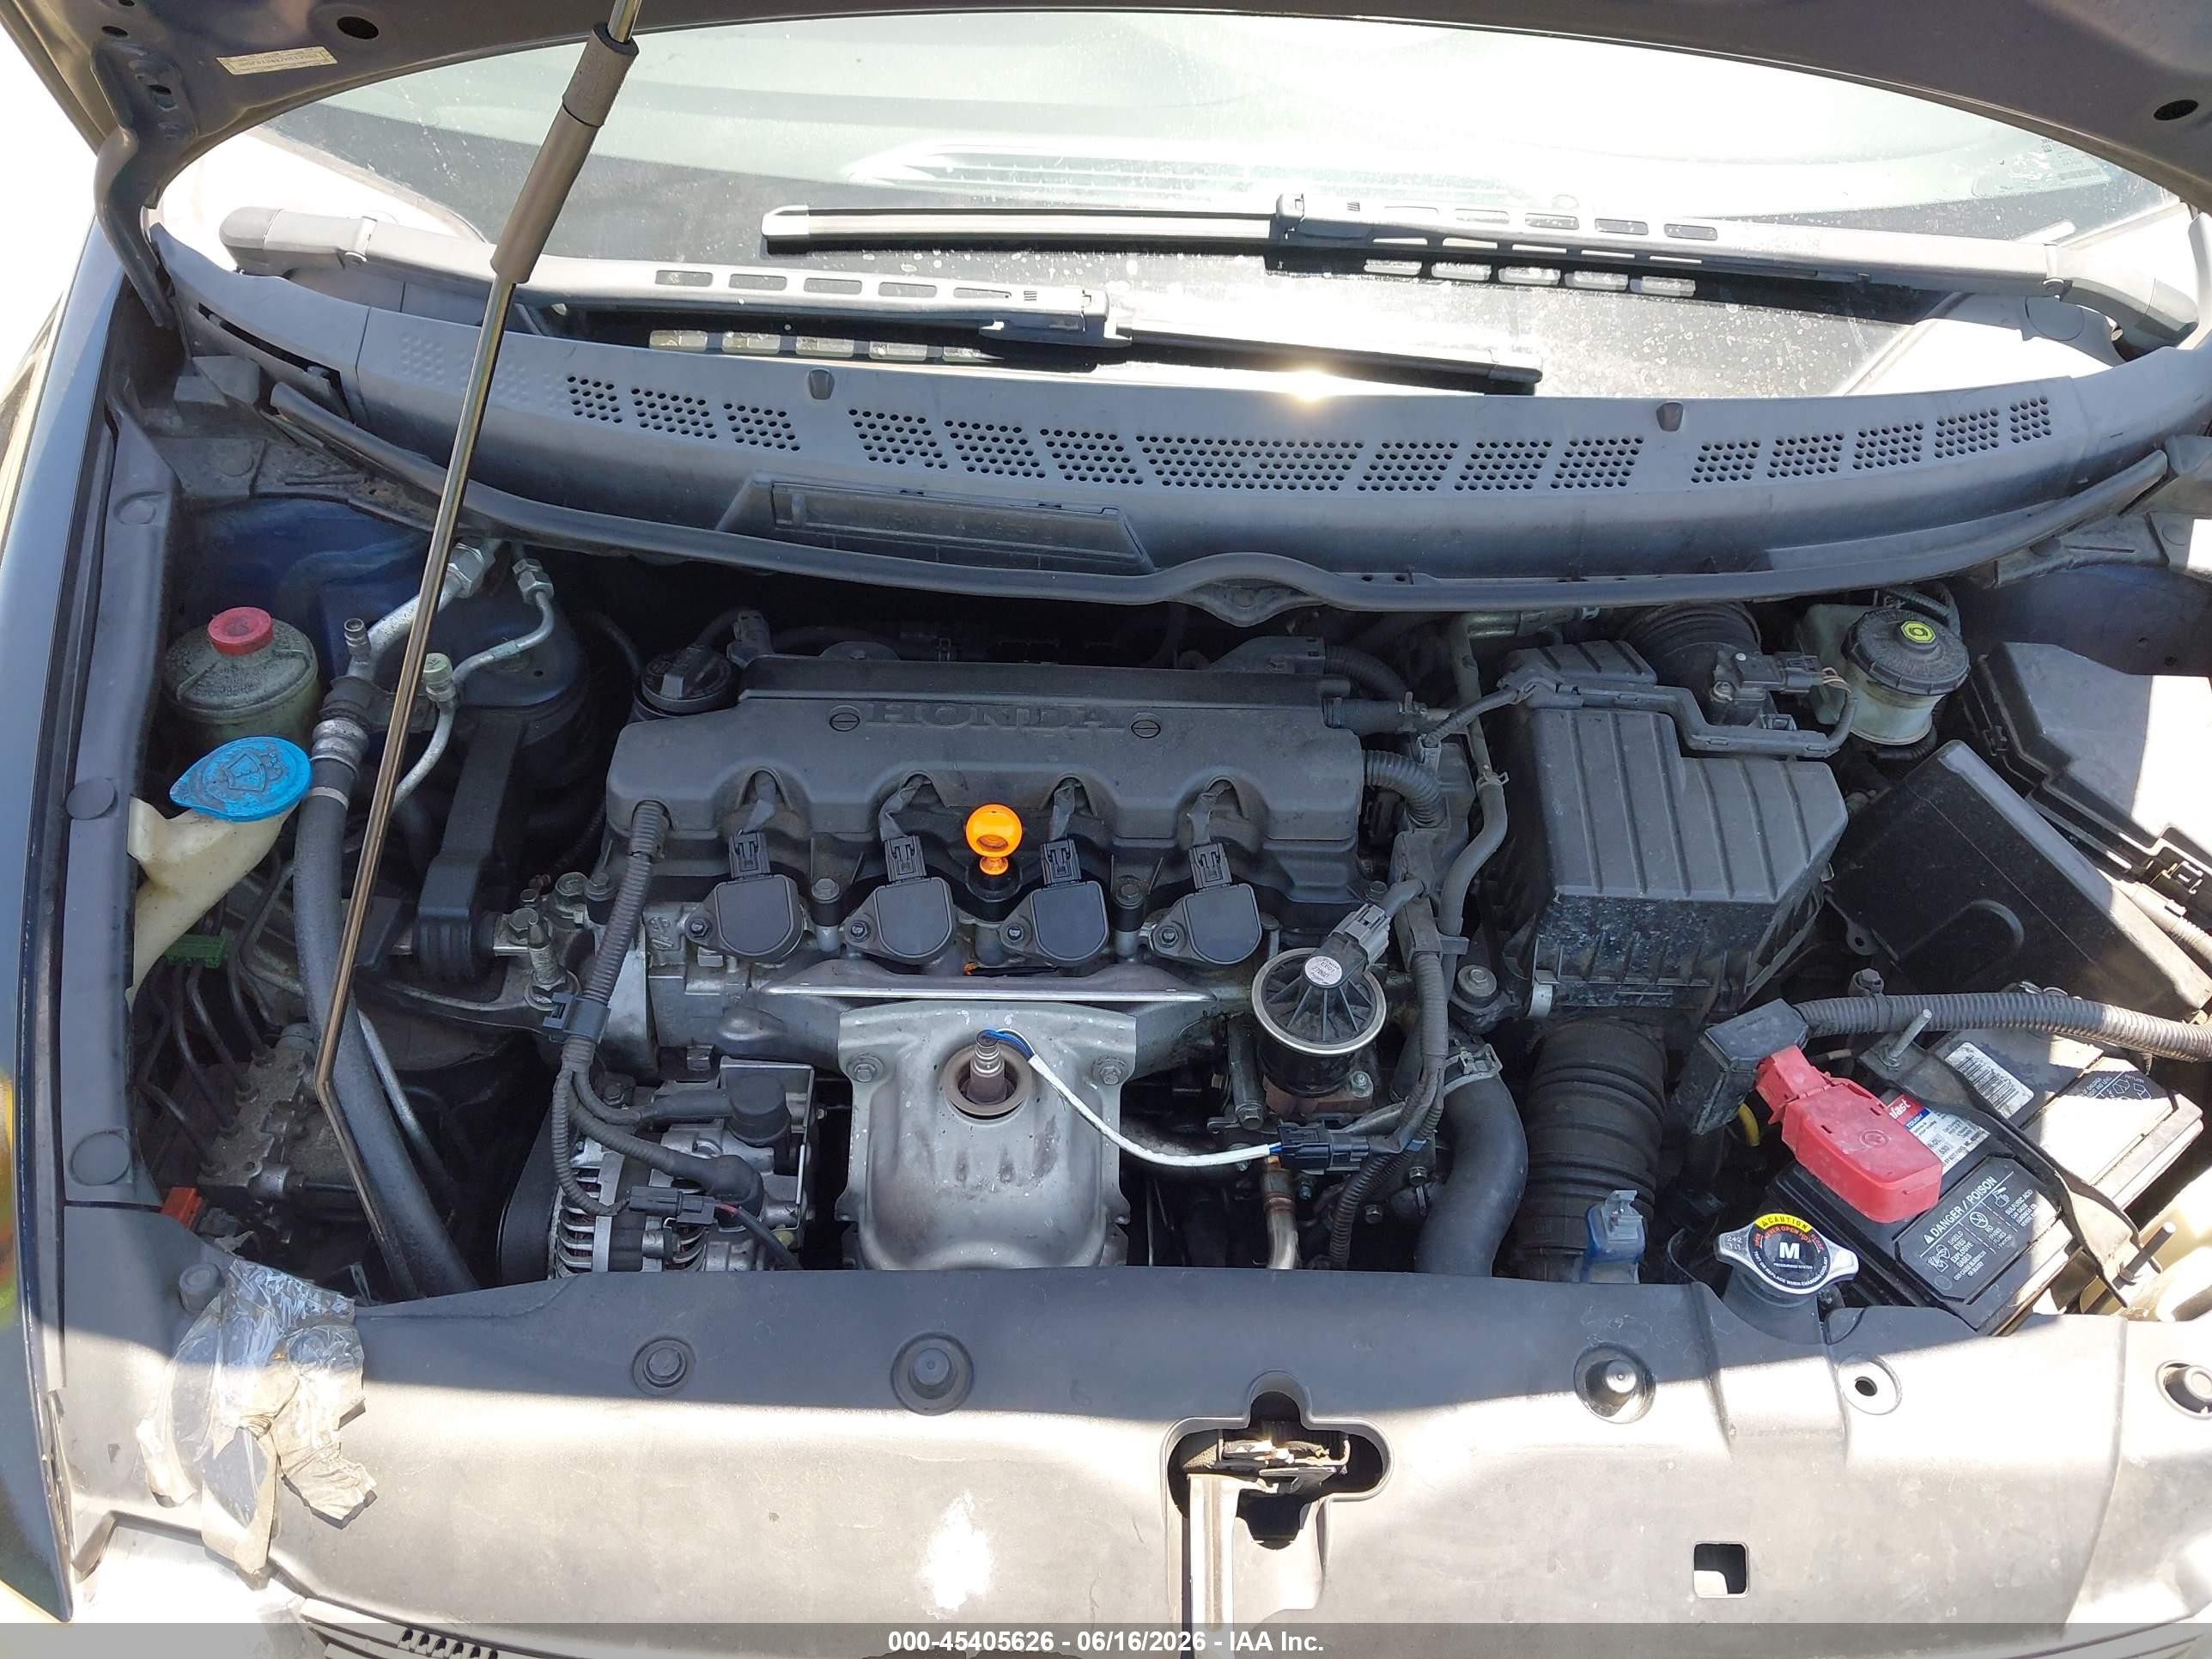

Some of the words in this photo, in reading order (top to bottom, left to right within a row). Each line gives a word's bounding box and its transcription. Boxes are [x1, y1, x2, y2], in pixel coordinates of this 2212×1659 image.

[866, 702, 1125, 730] HONDA
[1930, 1205, 1964, 1237] DANGER
[1966, 1176, 1996, 1204] POISON
[1769, 1217, 1808, 1229] CAUTION
[1781, 1226, 1799, 1235] OPEN
[1947, 1230, 1964, 1245] SHIELD
[1953, 1237, 1966, 1250] EYES
[1779, 1242, 1800, 1260] M
[1950, 1241, 1973, 1262] EXPLOSIVE
[1956, 1253, 1972, 1267] GASES
[1765, 1267, 1786, 1285] REPLACE
